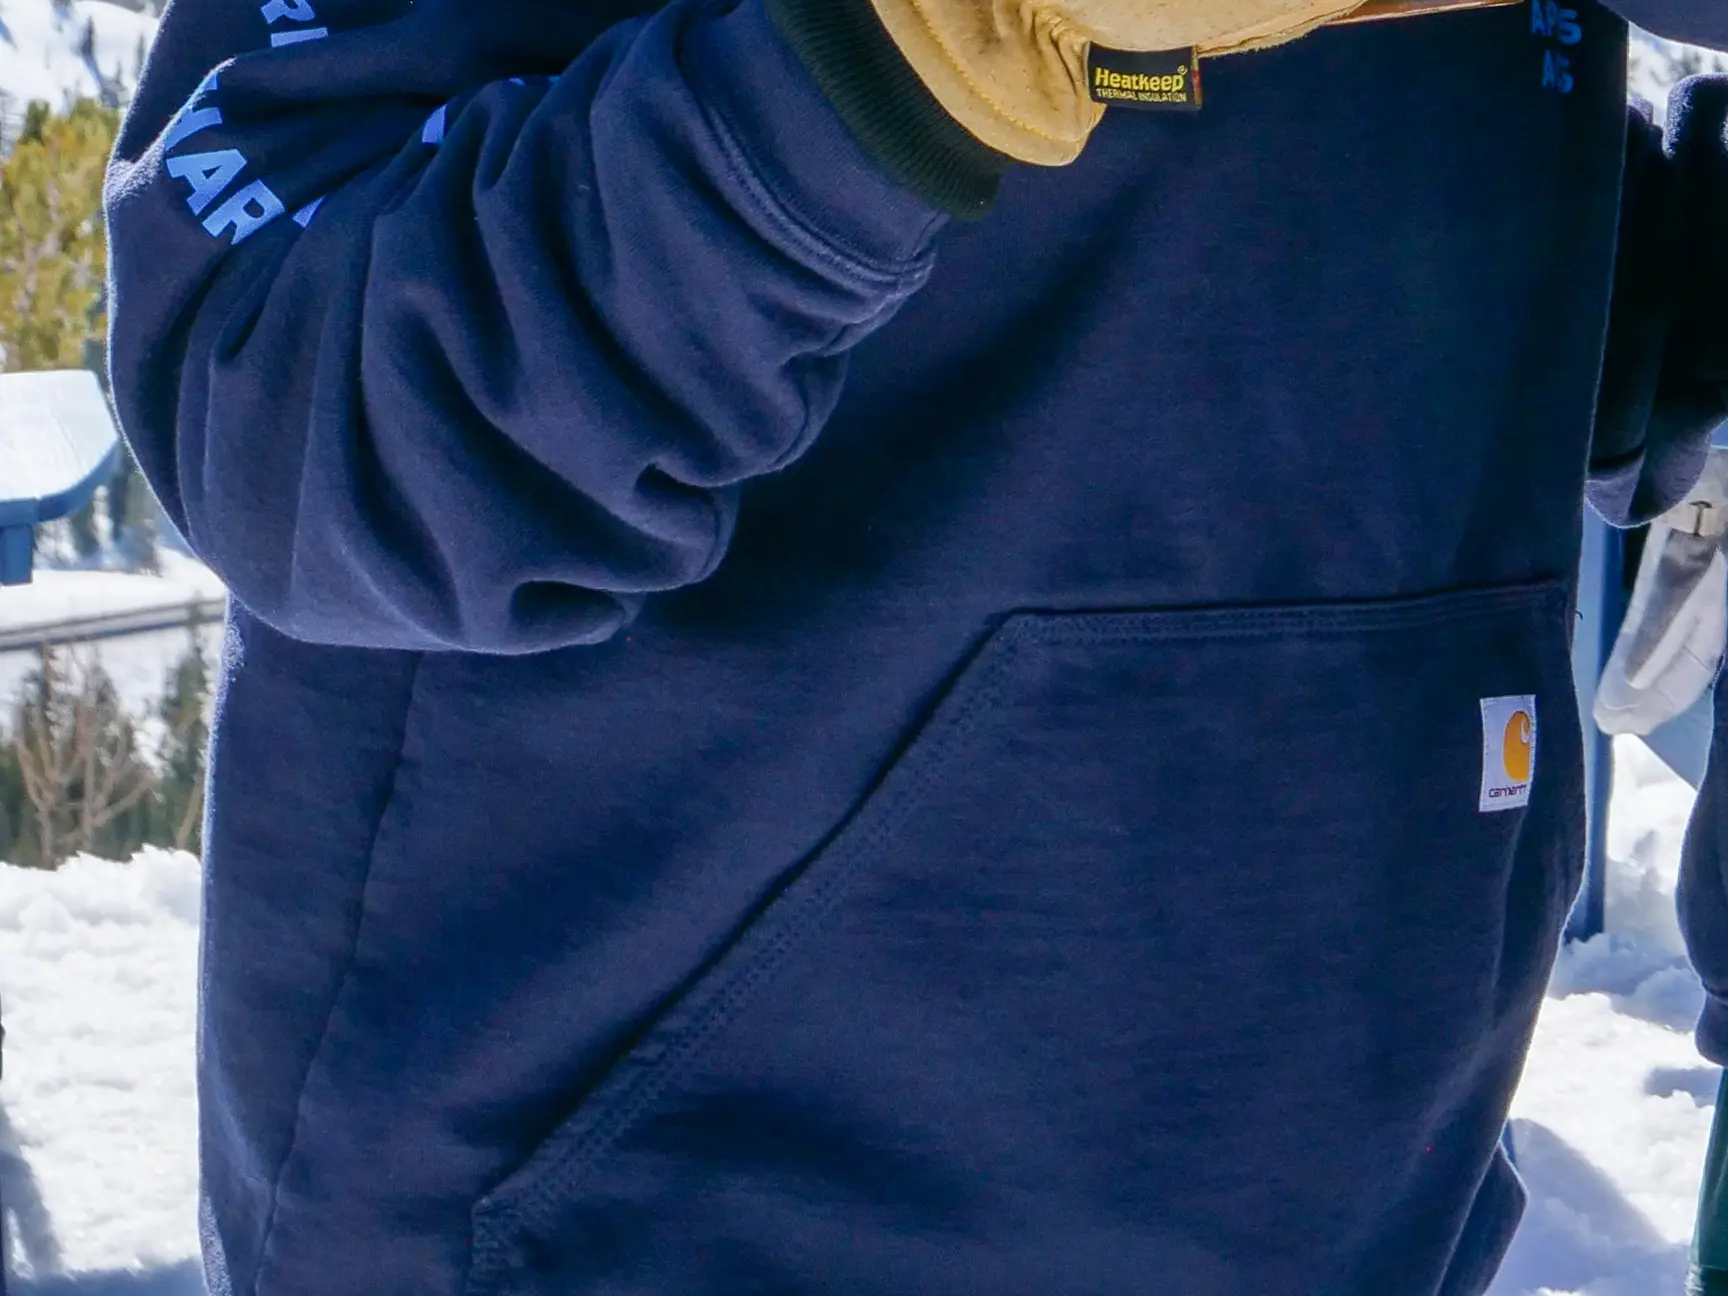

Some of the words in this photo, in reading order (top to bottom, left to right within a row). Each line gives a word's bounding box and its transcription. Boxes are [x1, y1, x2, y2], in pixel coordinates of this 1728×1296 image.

[1096, 88, 1138, 101] THERMAL
[1138, 91, 1187, 103] INSULATION
[1488, 784, 1528, 799] carhartt
